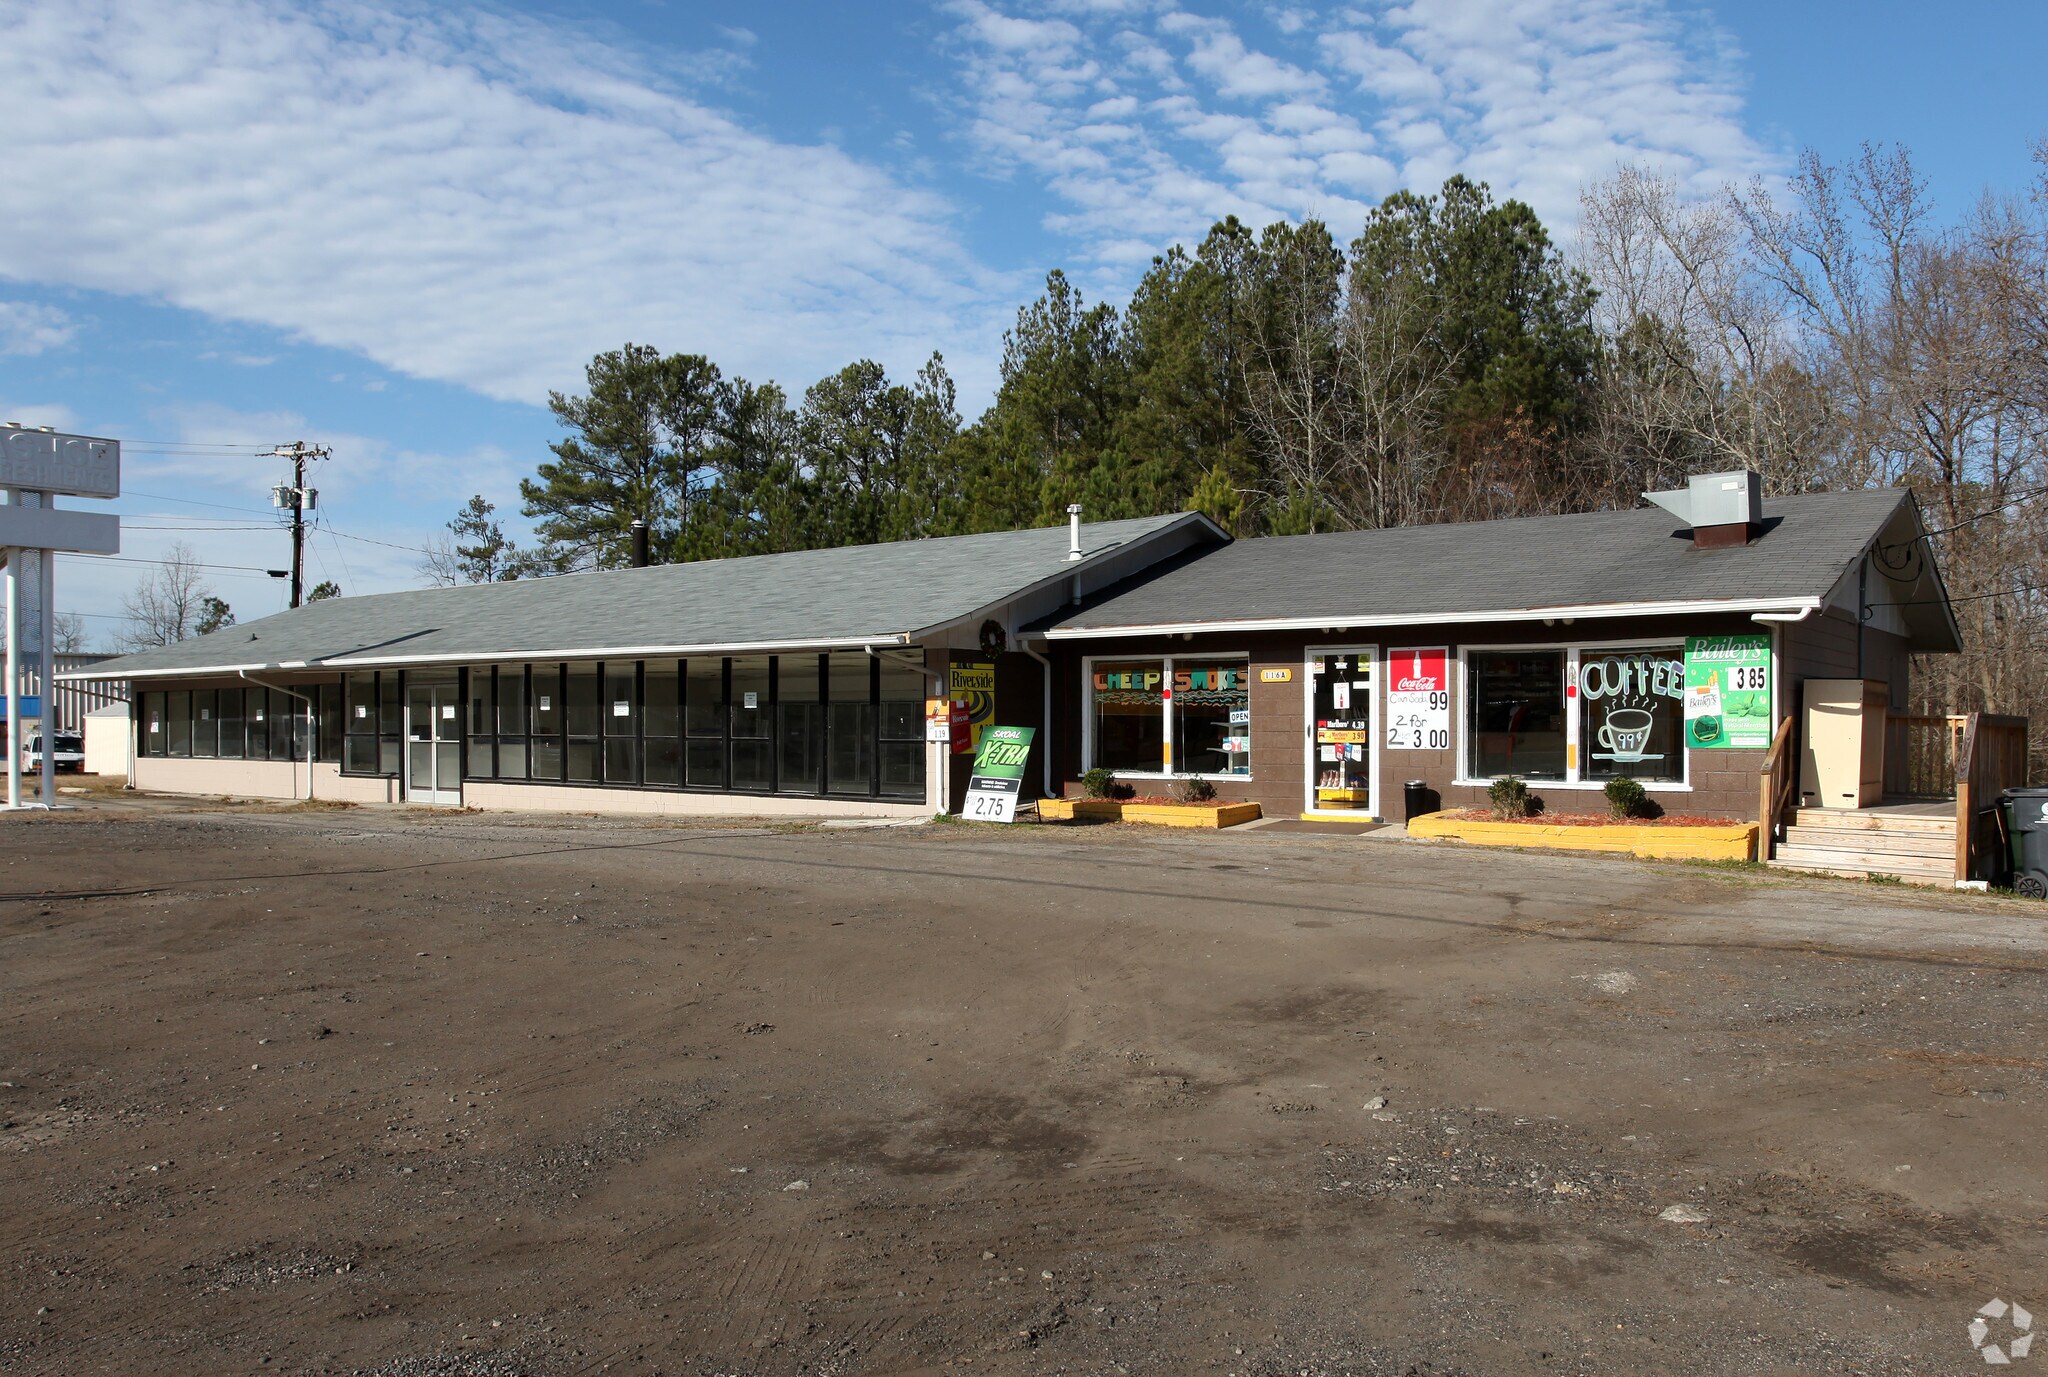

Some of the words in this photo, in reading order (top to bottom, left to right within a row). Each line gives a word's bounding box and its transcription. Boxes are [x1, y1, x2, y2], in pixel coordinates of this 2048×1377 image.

[1691, 637, 1763, 664] Bailey's
[952, 671, 993, 688] Riverside
[1094, 668, 1160, 691] CHEEP
[1174, 666, 1248, 691] SMOKES
[1581, 654, 1685, 700] COFFEE
[1689, 694, 1717, 708] Bailey's
[1231, 713, 1248, 722] OPEN
[1396, 715, 1408, 726] 2
[1410, 714, 1427, 727] for
[992, 730, 1023, 739] SKOAL
[973, 740, 1031, 768] X-TRA
[975, 797, 1004, 816] 2.75
